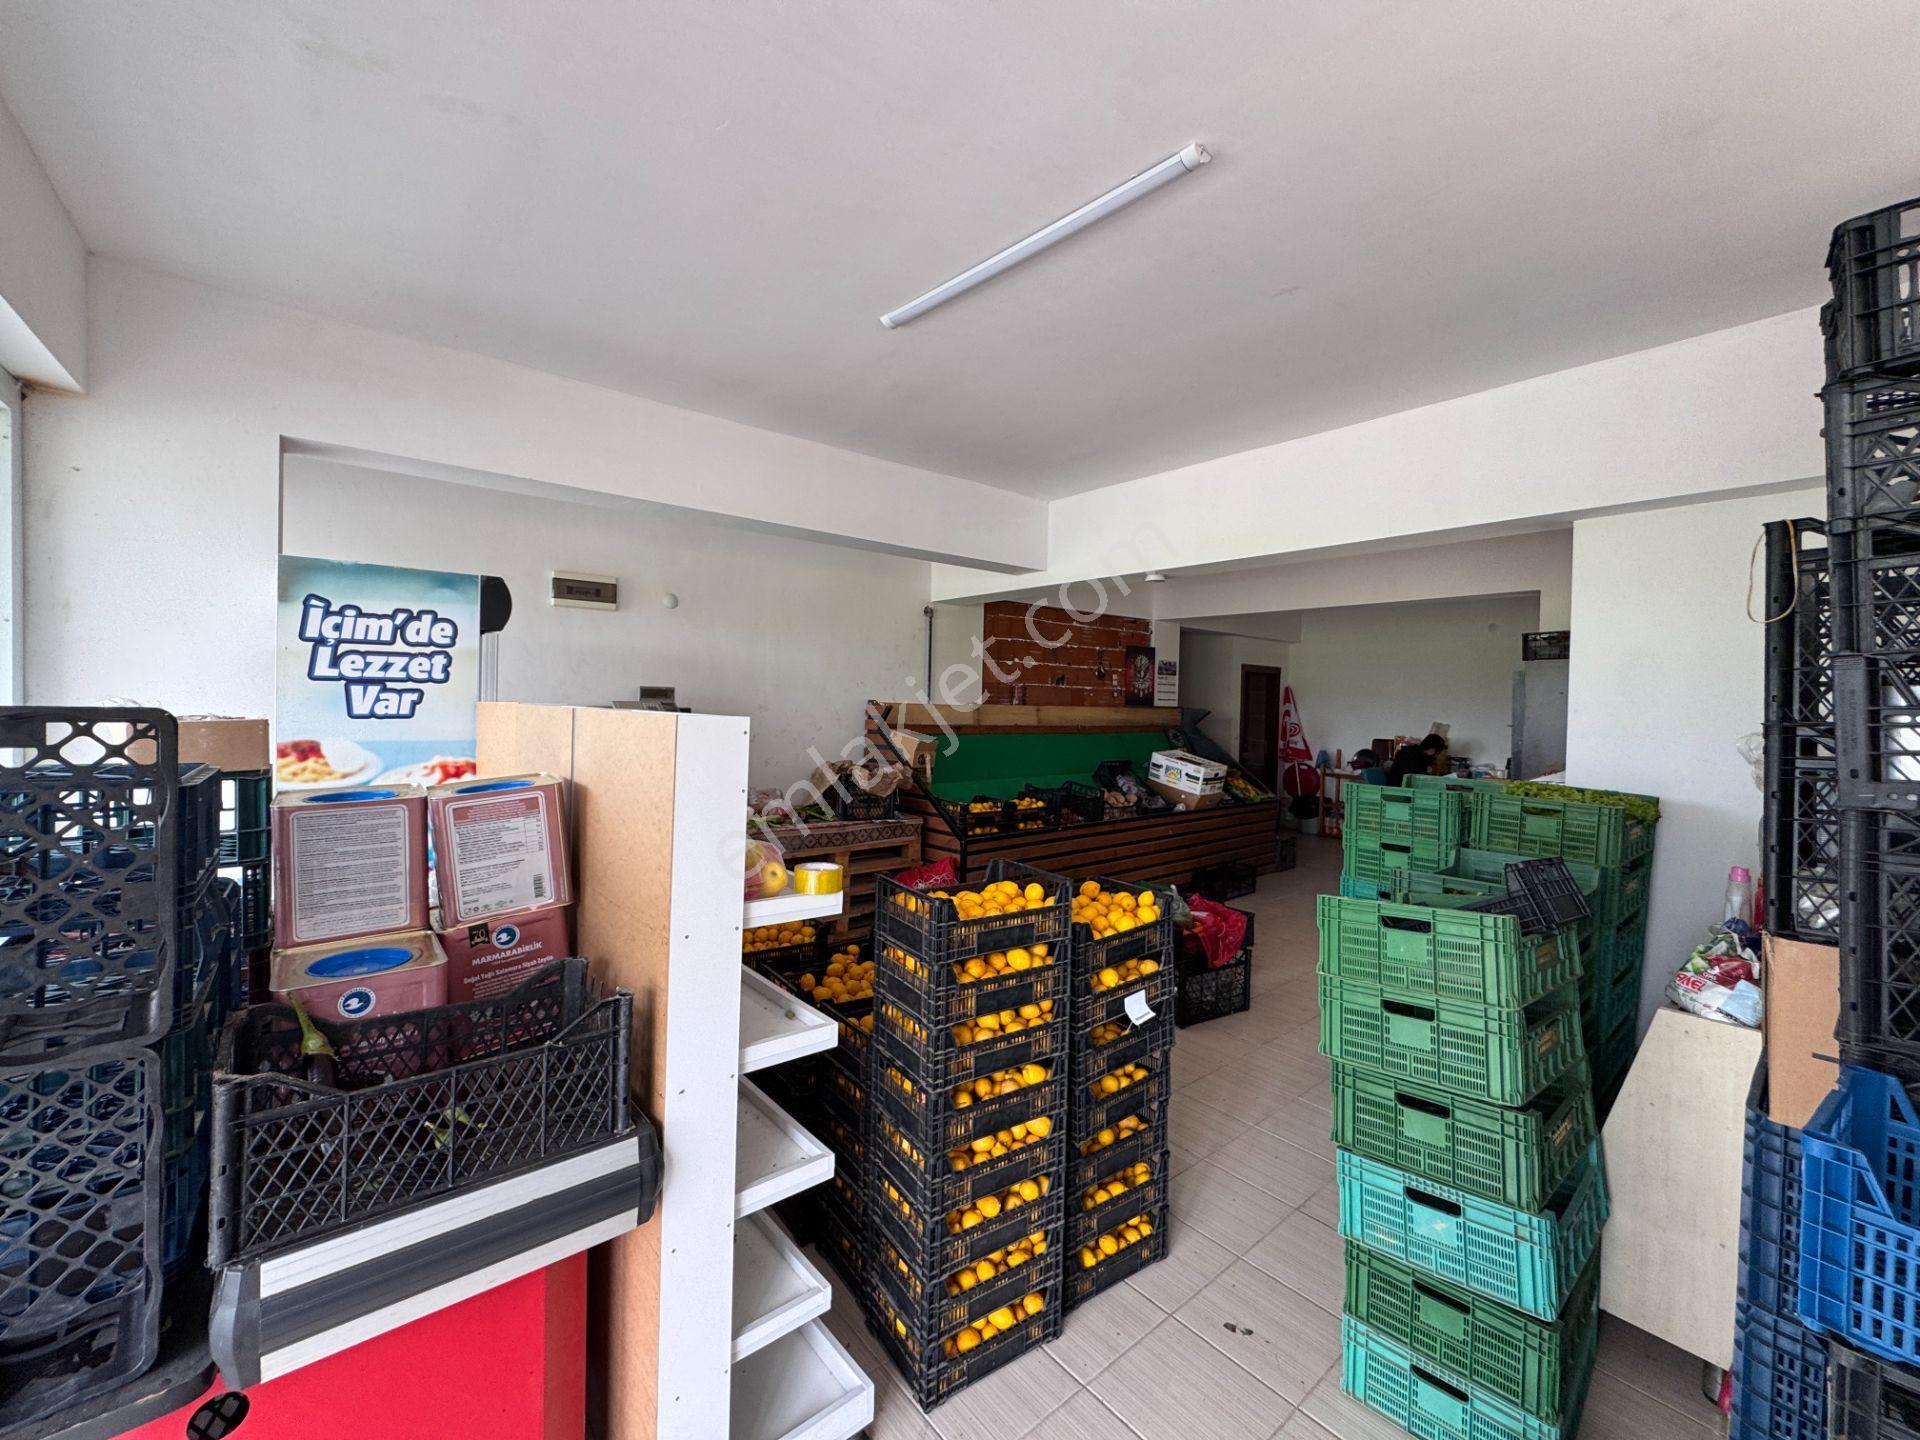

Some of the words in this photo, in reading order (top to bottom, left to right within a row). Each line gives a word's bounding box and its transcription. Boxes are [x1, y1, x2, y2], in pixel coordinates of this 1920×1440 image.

[299, 595, 457, 646] İçim'de
[310, 645, 451, 682] Lezzet
[346, 682, 423, 718] Var
[472, 941, 542, 966] MARMARABİRLİK
